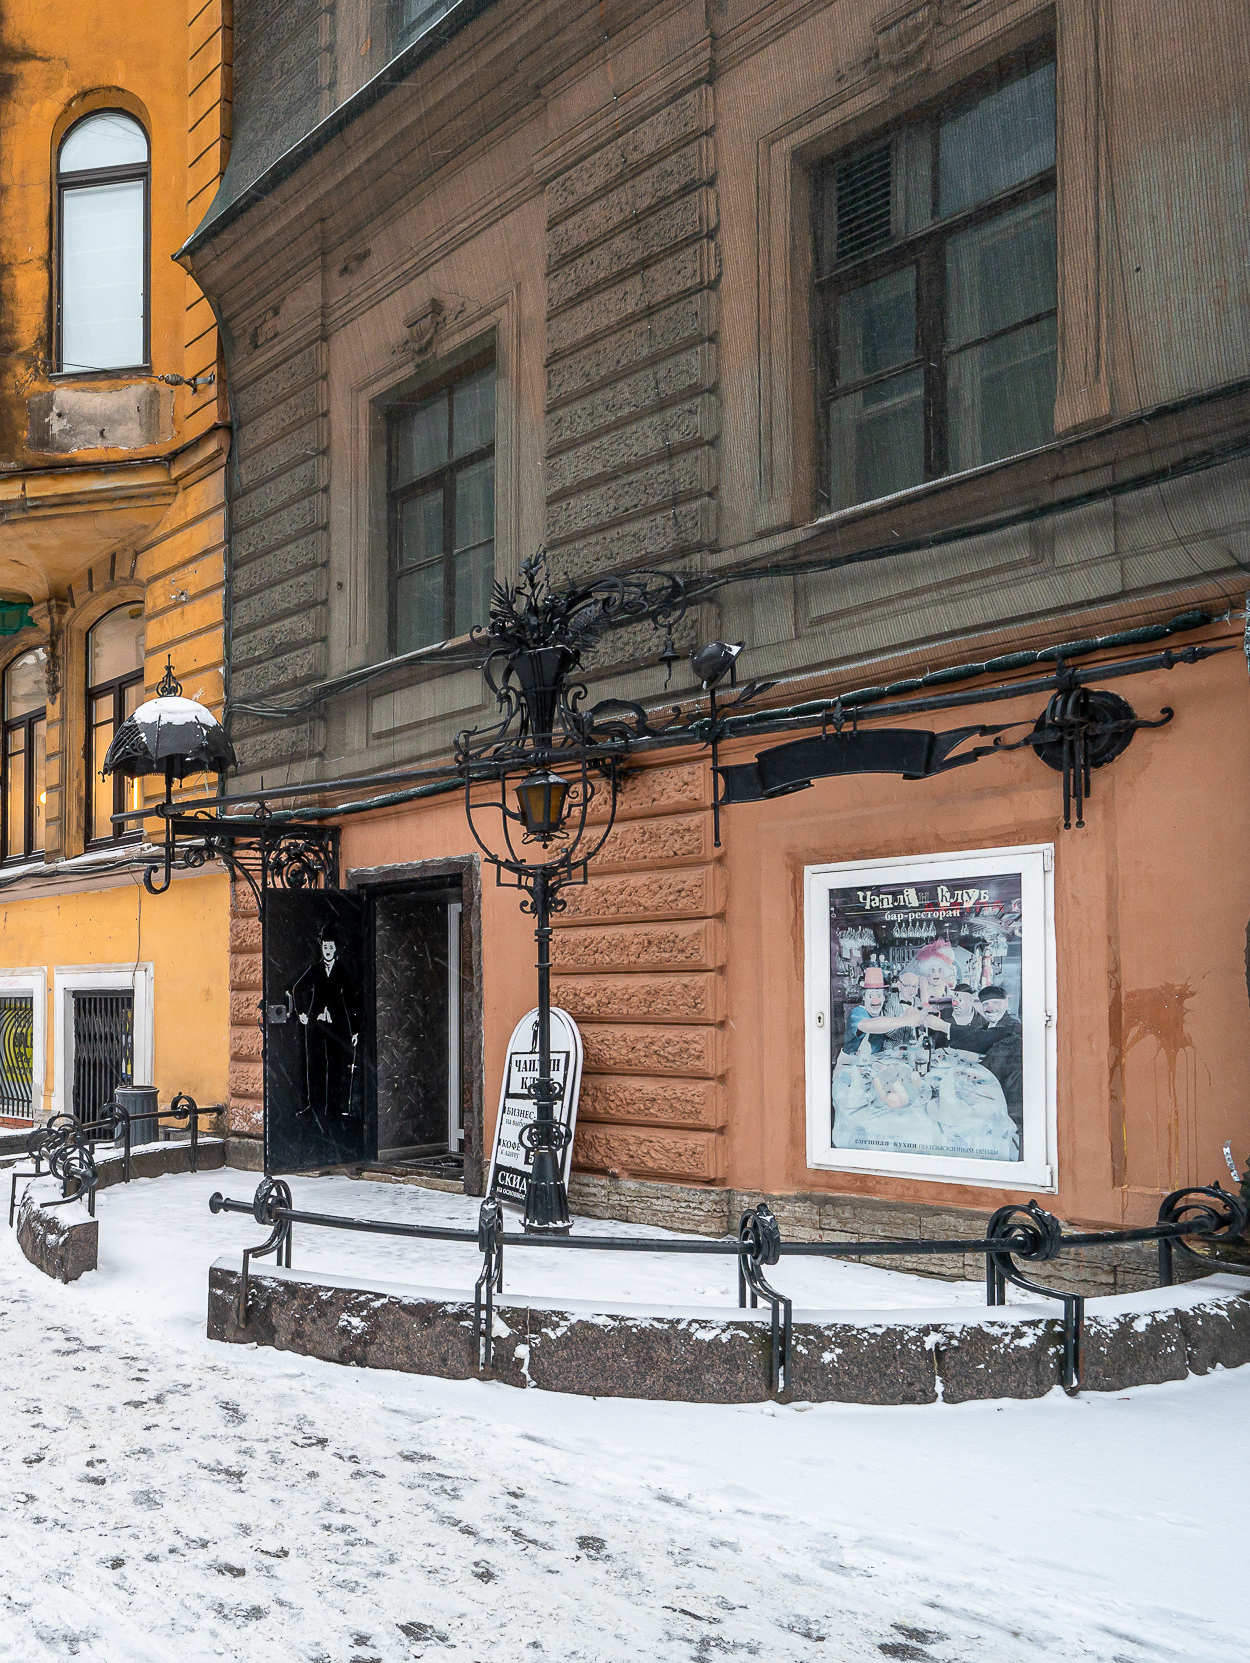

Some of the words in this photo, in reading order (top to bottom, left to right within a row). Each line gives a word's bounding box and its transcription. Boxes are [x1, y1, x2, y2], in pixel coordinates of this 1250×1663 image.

[884, 908, 961, 923] бар-ресторан
[501, 1138, 521, 1152] КОФЕ
[854, 1137, 890, 1147] смешная
[893, 1140, 917, 1150] кухня
